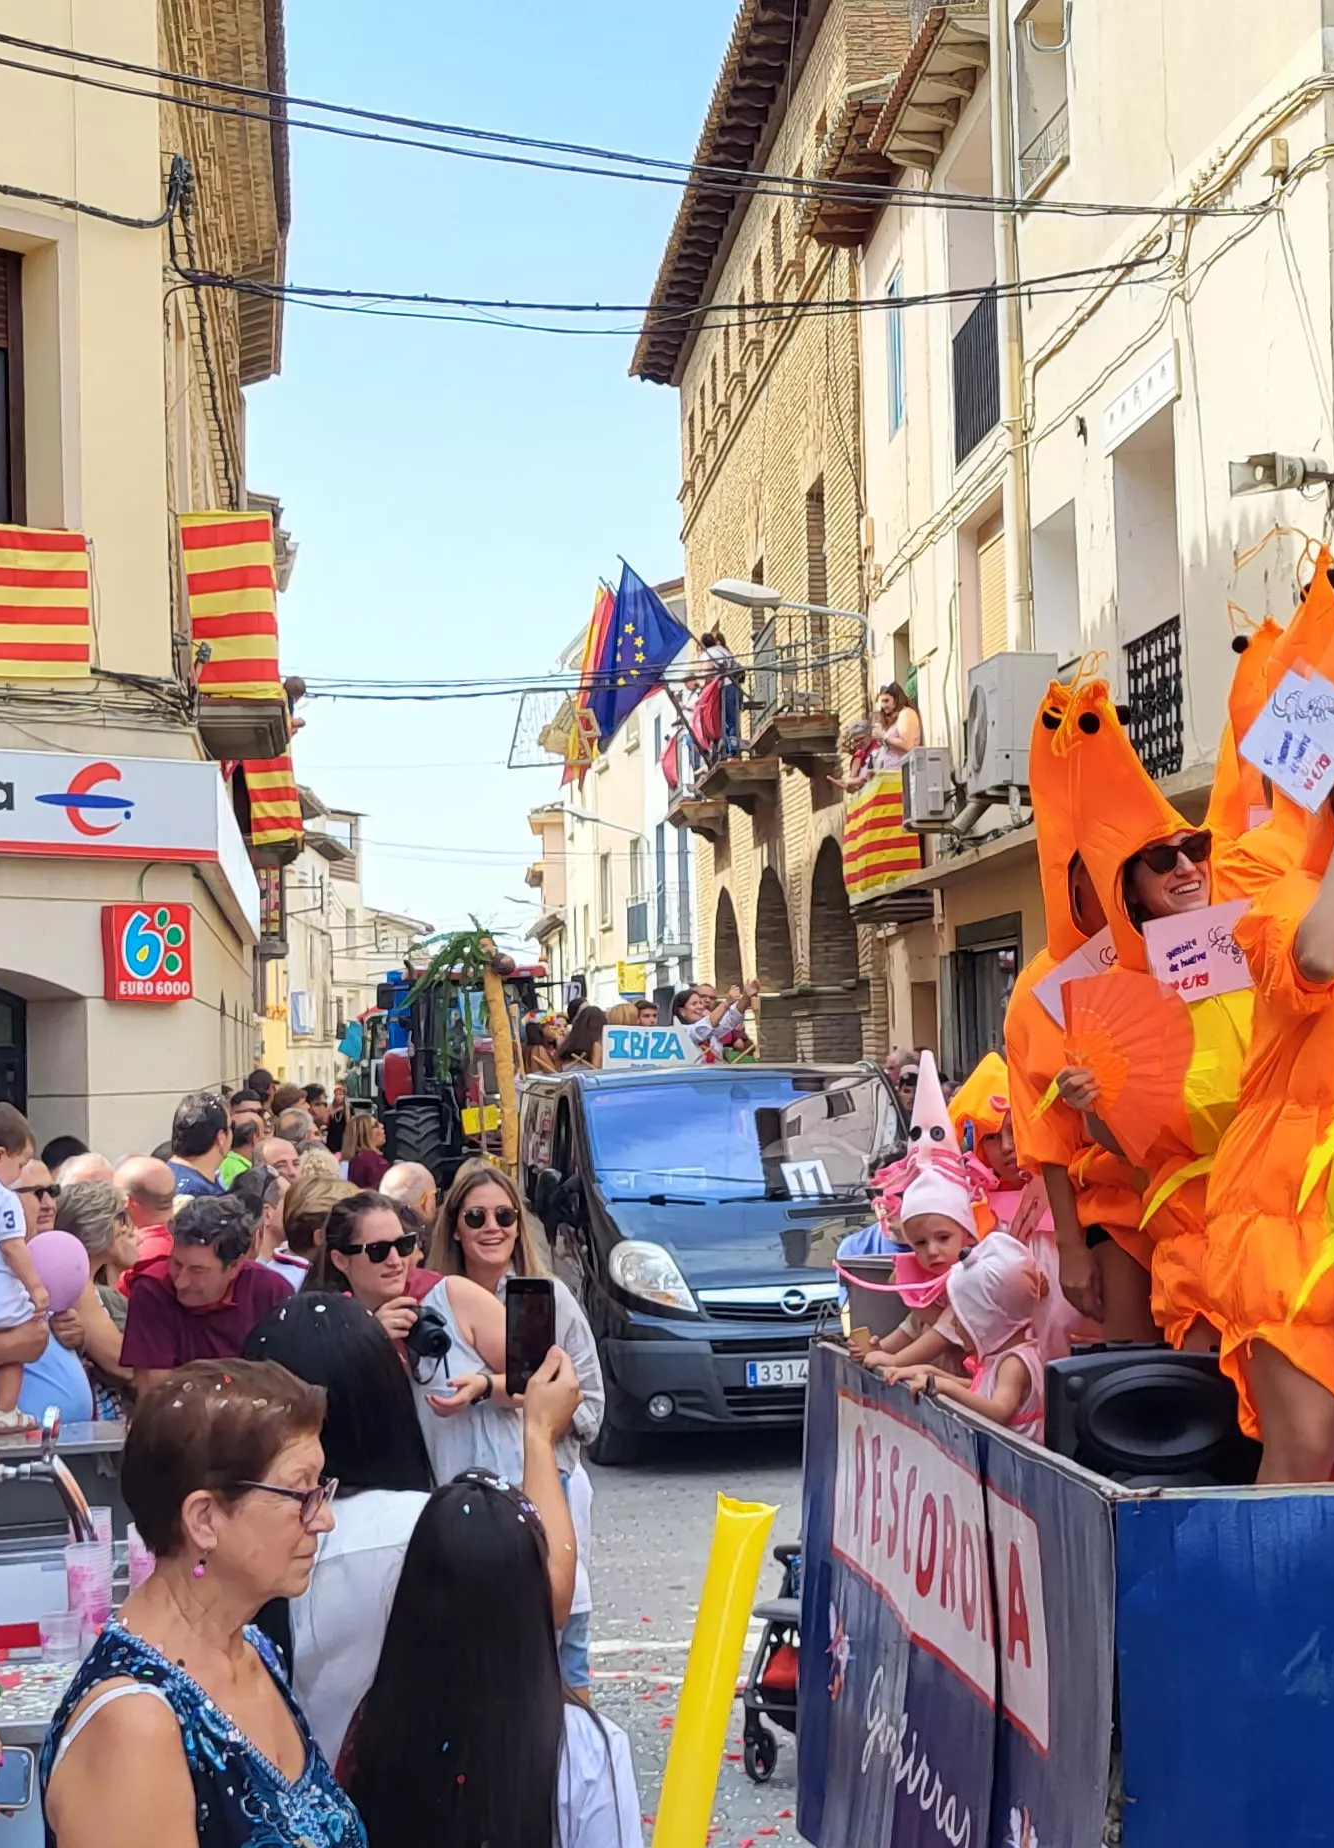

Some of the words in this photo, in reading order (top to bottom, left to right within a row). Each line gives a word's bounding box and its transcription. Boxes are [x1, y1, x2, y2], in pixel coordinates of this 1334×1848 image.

[119, 981, 154, 995] EURO
[155, 981, 190, 995] 6000
[790, 1163, 825, 1196] 11
[3, 1210, 16, 1229] 3
[760, 1363, 808, 1382] 3314
